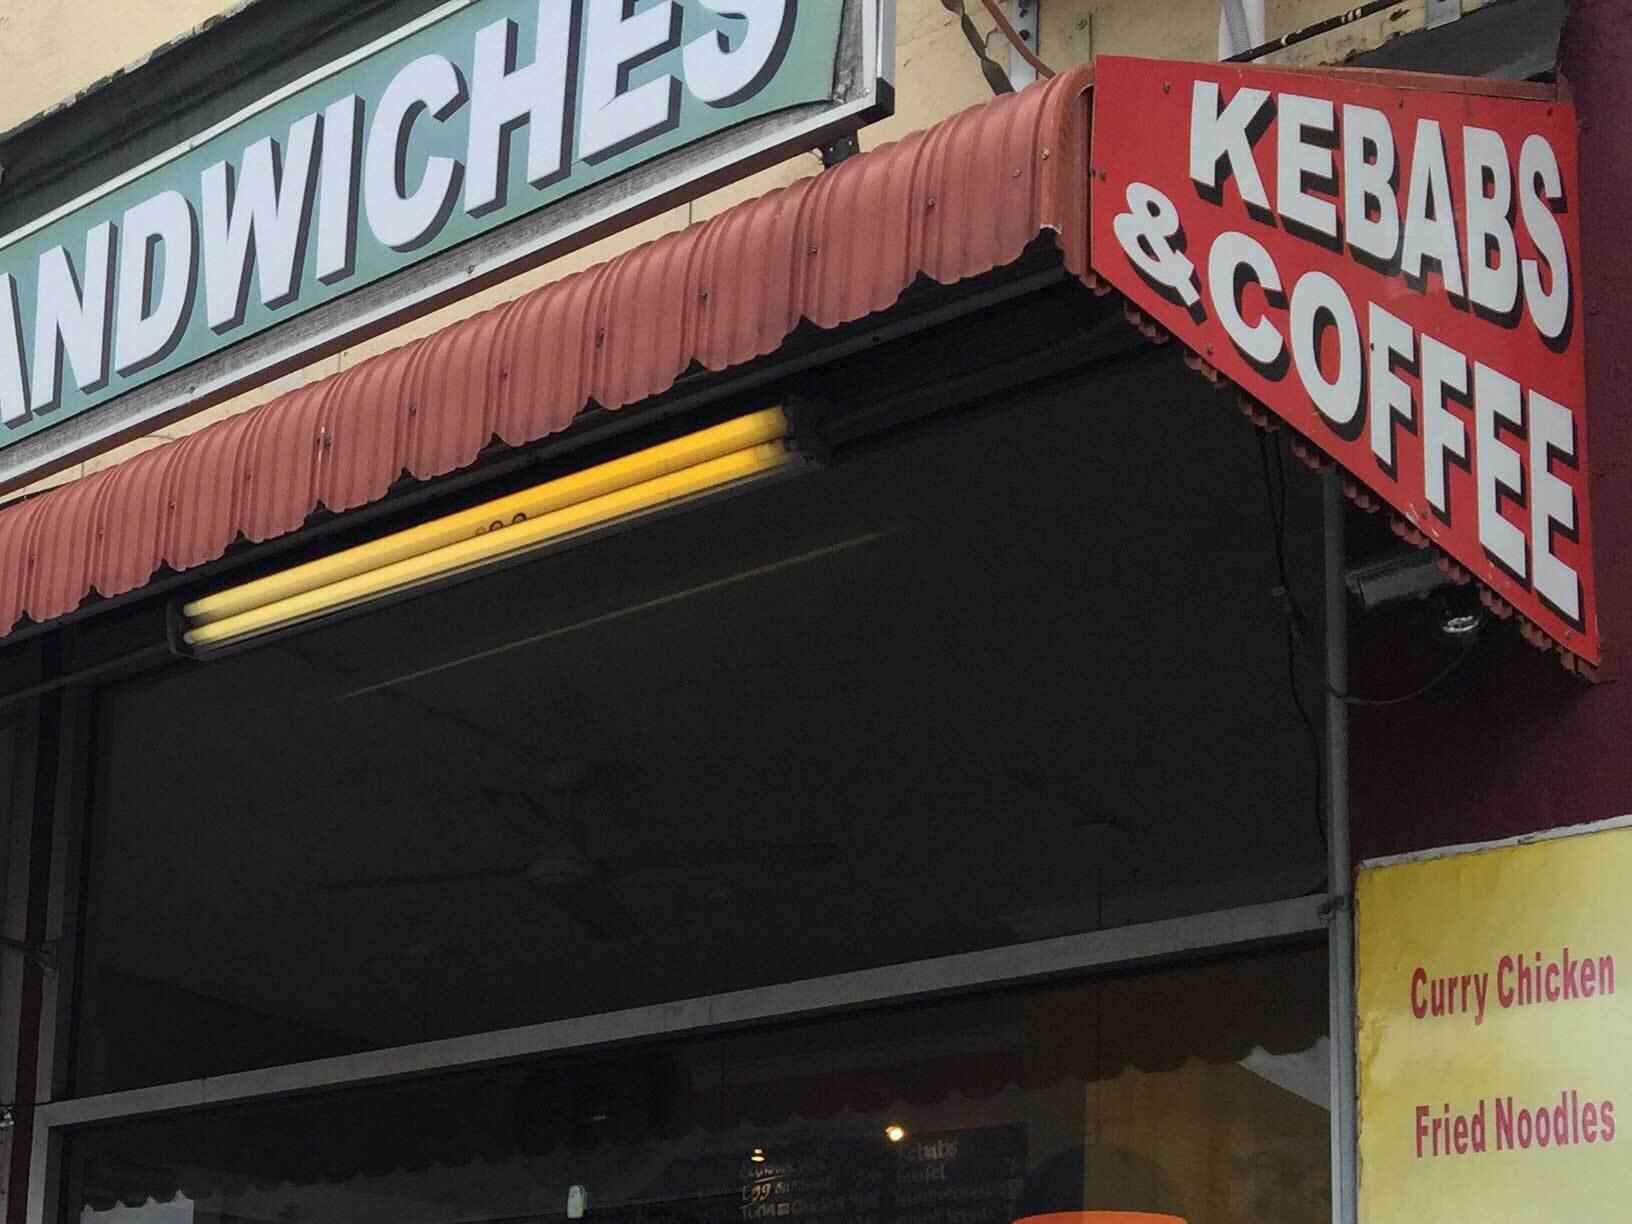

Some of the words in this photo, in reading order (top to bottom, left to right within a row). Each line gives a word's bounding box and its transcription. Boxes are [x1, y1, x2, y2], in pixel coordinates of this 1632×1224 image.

[1189, 80, 1569, 340] KEBABS
[1113, 182, 1200, 307] &
[1208, 231, 1580, 621] COFFEE
[1411, 967, 1489, 1026] Curry
[1497, 948, 1614, 1008] Chicken
[1416, 1099, 1486, 1158] Fried
[1495, 1090, 1615, 1150] Noodles
